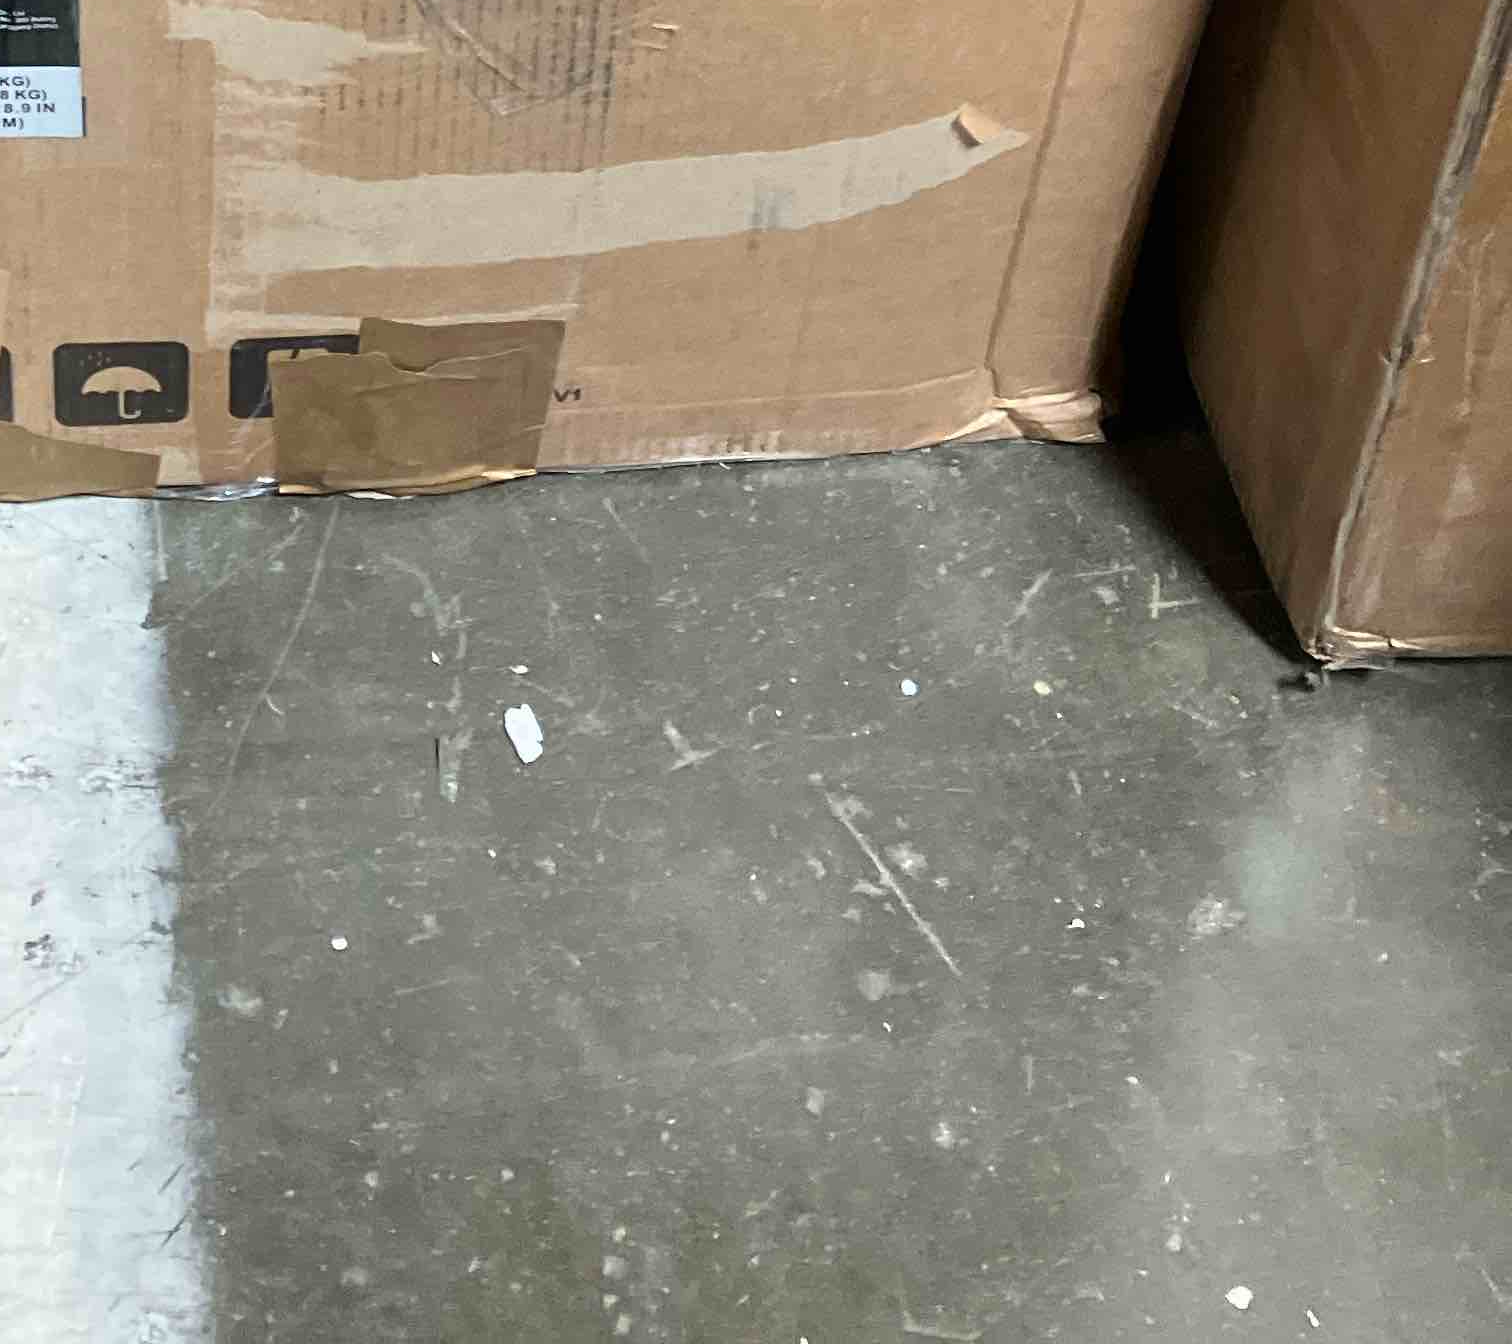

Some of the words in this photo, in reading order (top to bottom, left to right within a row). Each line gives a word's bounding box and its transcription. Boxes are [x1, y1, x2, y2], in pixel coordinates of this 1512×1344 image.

[0, 76, 31, 88] KG)
[15, 90, 47, 102] KG)
[36, 103, 56, 113] IN
